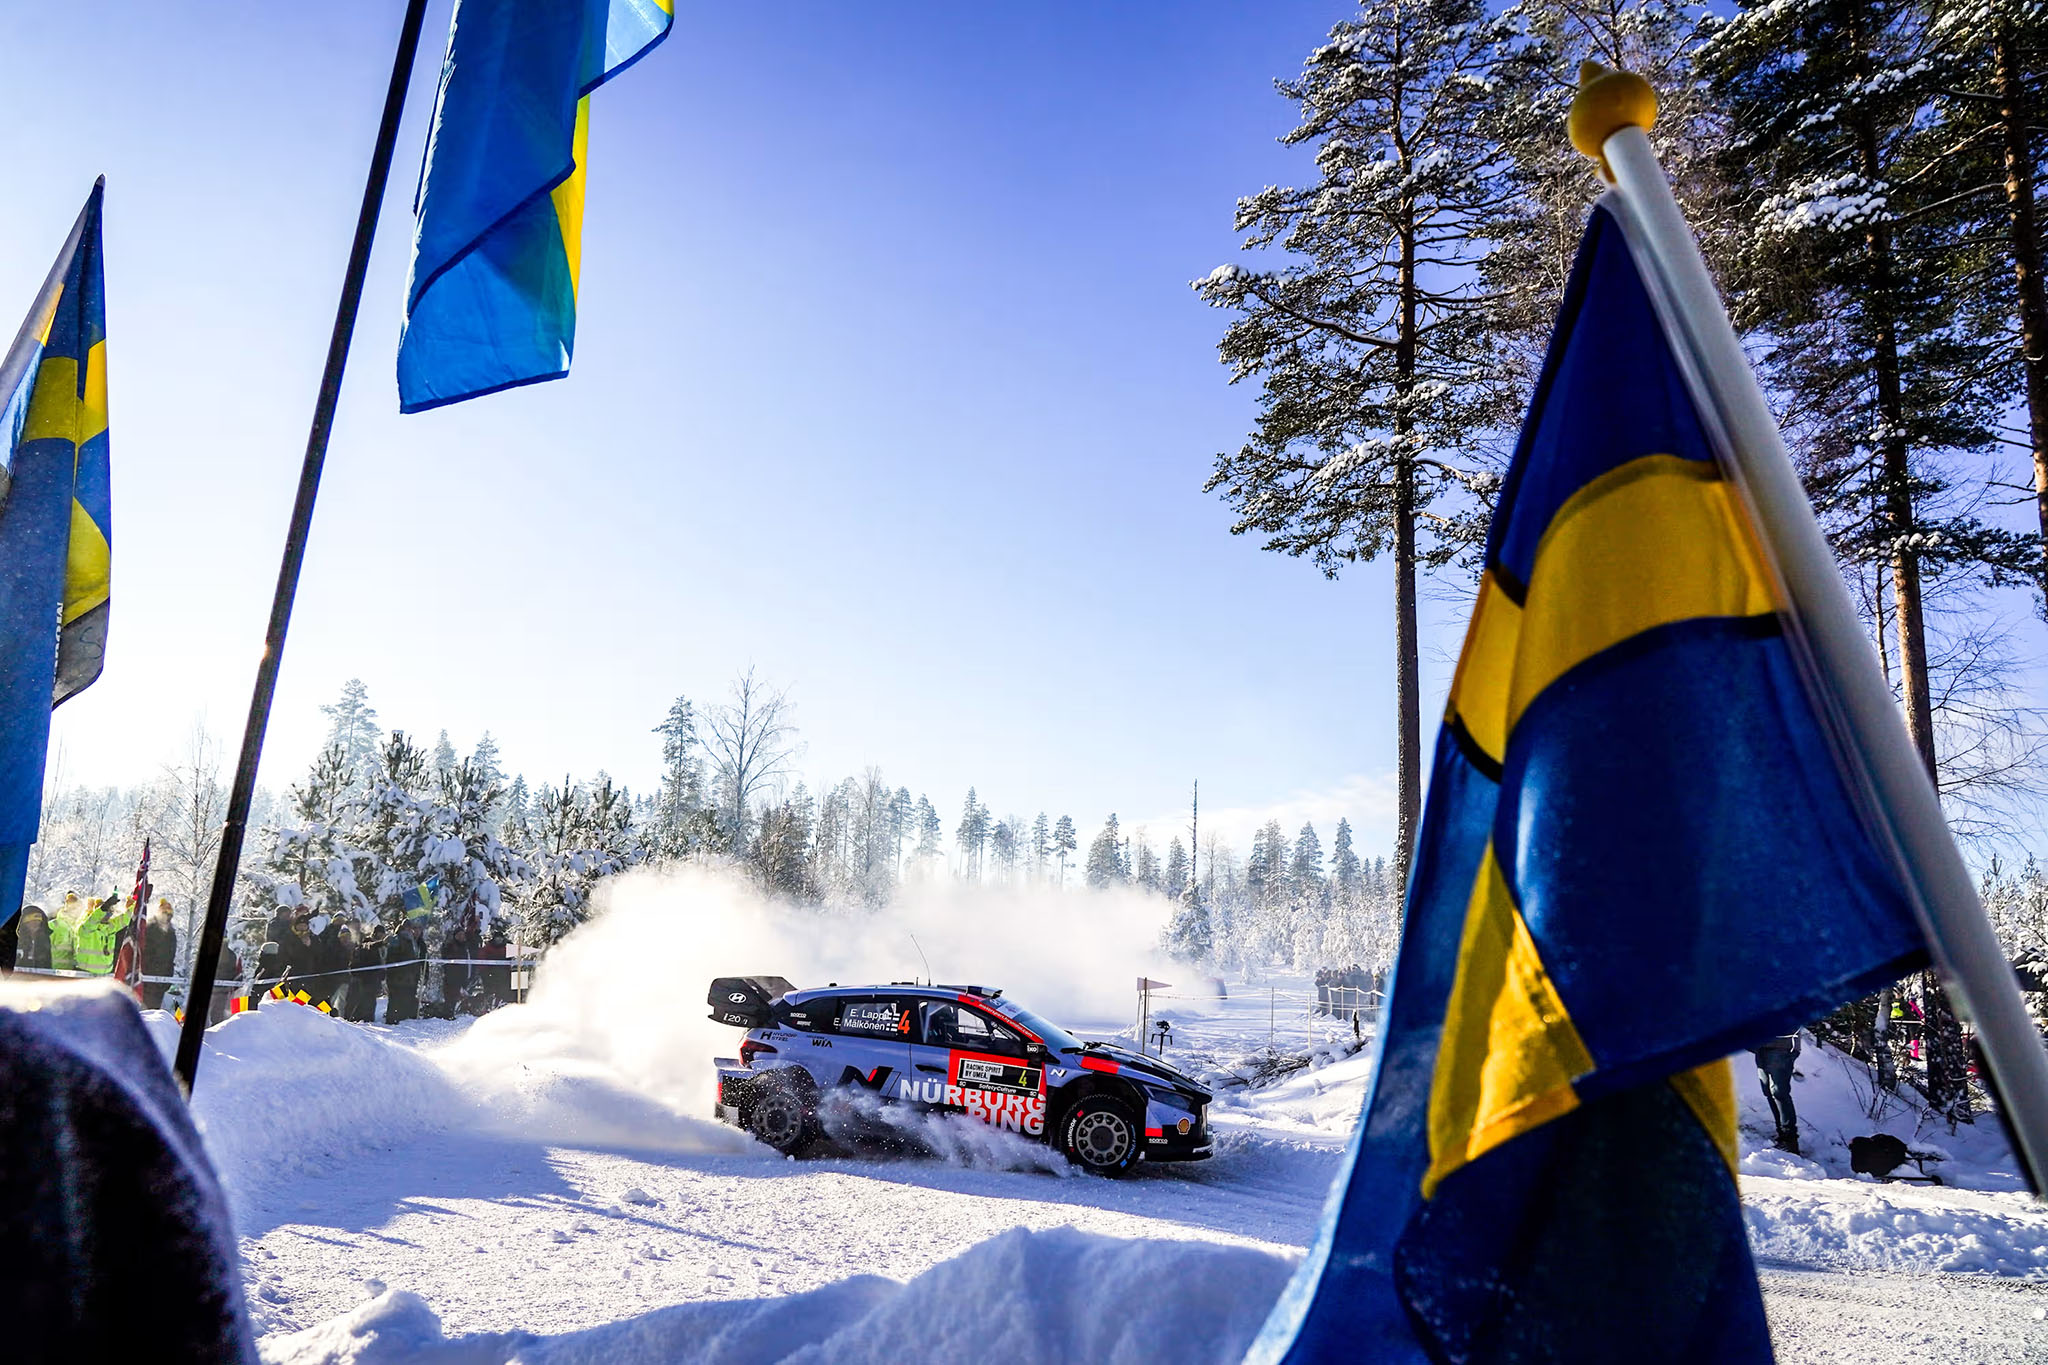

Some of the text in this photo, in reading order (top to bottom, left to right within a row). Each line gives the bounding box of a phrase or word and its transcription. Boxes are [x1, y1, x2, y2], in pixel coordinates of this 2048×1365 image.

[850, 1008, 860, 1018] E.
[833, 1017, 842, 1027] E.
[897, 1009, 911, 1034] 4
[966, 1063, 1002, 1074] RACING SPIRIT
[1018, 1069, 1028, 1087] 4
[978, 1083, 1017, 1094] SafetyCulture
[900, 1077, 1047, 1114] NÜRBURG
